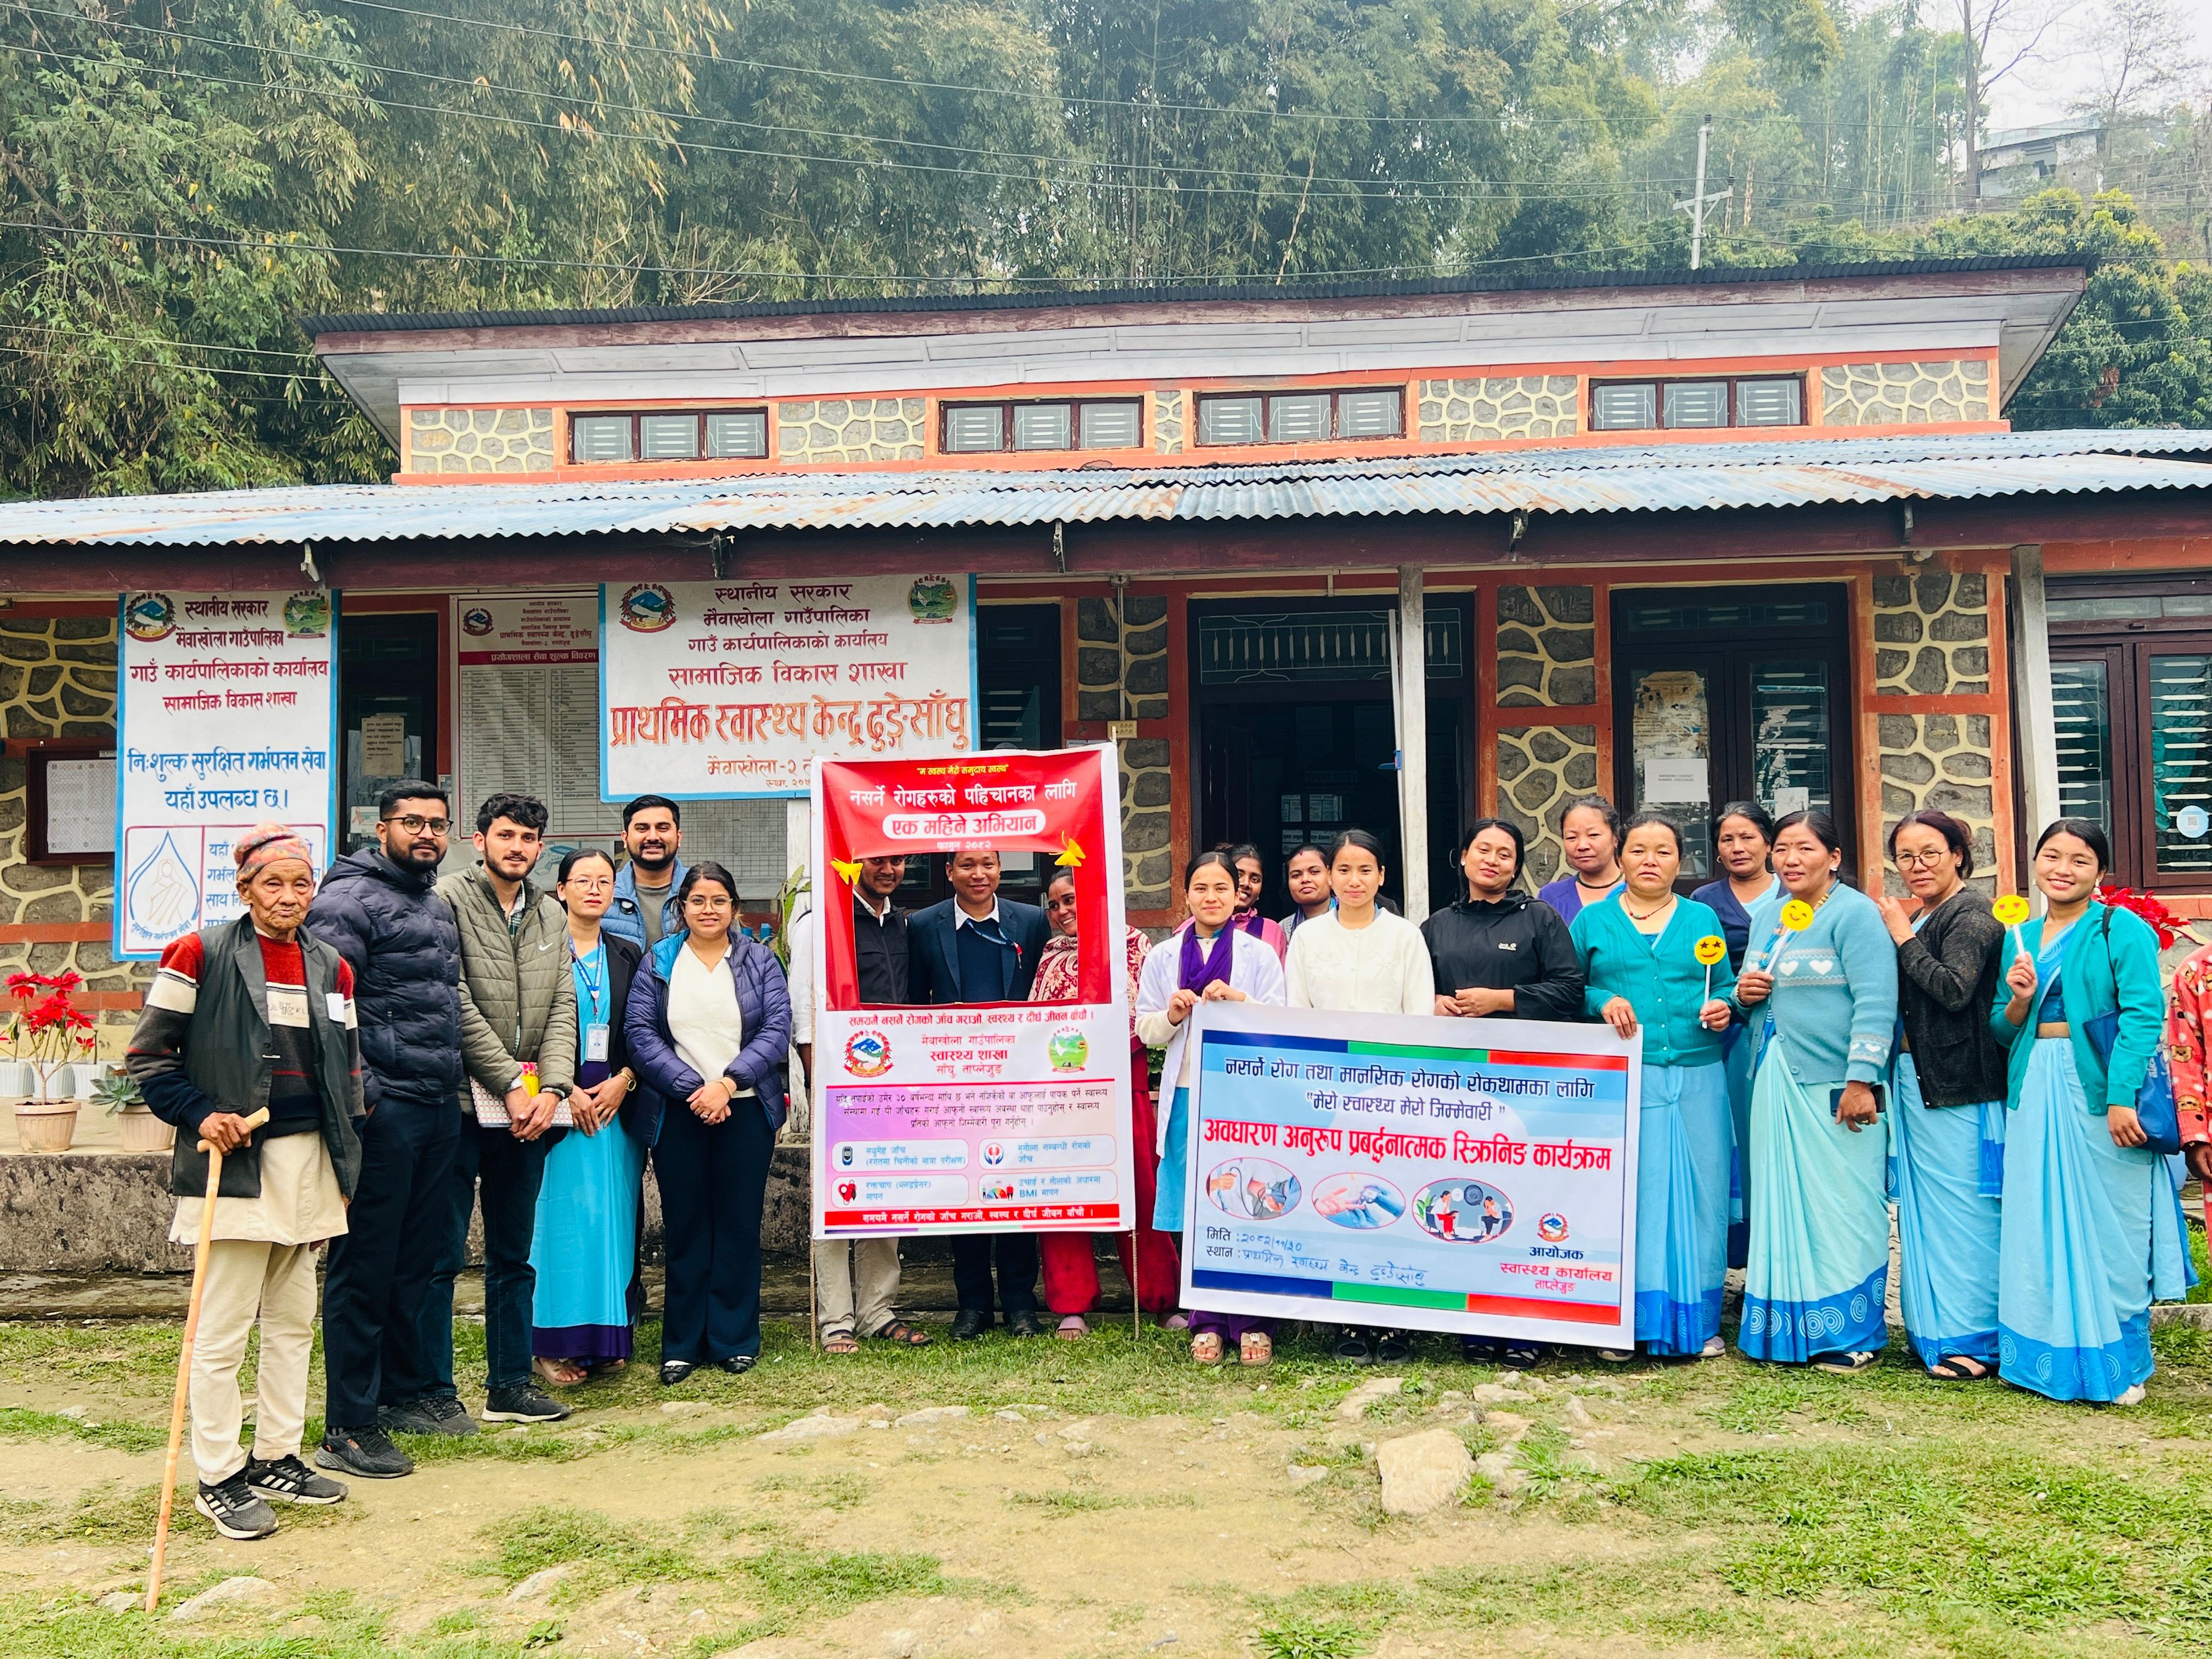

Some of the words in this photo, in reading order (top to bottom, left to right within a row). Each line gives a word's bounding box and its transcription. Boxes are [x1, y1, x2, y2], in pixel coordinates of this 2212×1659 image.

[715, 582, 778, 602] स्थानीय
[788, 584, 853, 602] सरकार
[184, 596, 229, 620] स्थानीय
[231, 600, 269, 621] सरकार
[703, 607, 773, 627] मैवाखोला
[784, 605, 871, 625] गाउँपालिका
[176, 626, 227, 651] मैवाखोला
[229, 627, 284, 650] गाउँपालिका
[689, 634, 718, 653] गाउँ
[723, 631, 828, 653] कार्यपालिकाको
[834, 631, 888, 650] कार्यालय
[491, 653, 531, 662] प्रयोगशाला
[549, 652, 568, 662] शुल्क
[571, 650, 596, 659] विवरण
[130, 658, 159, 682] गाउँ
[165, 658, 269, 681] कार्यपालिकाको
[273, 657, 329, 680] कार्यालय
[668, 661, 763, 687] सामाजिक
[773, 659, 838, 684] विकास
[849, 661, 908, 687] शाखा
[162, 690, 221, 715] सामाजिक
[225, 690, 263, 712] विकास
[266, 692, 297, 710] शाखा
[610, 696, 711, 748] प्राथमिक
[715, 702, 807, 744] स्वास्थ्य
[812, 694, 866, 747] केन्द्र
[192, 746, 245, 780] सुरक्षित
[248, 747, 298, 774] गर्भपतन
[301, 747, 325, 774] सेवा
[961, 765, 986, 776] समुदाय
[164, 783, 194, 812] यहाँ
[198, 790, 259, 811] उपलब्ध
[850, 785, 885, 807] नसर्ने
[964, 783, 1035, 806] पहिचानका
[1044, 780, 1077, 801] लागि
[891, 821, 918, 835] एक
[925, 815, 969, 836] महिने
[972, 812, 1038, 834] अभियान
[209, 839, 228, 856] यहाँ
[906, 1013, 933, 1025] रोगको
[1018, 1015, 1023, 1023] र
[1045, 1011, 1067, 1022] जीवन
[969, 1032, 1016, 1045] गाउँपालिका
[929, 1049, 973, 1060] स्वास्थ्य
[978, 1049, 1008, 1059] शाखा
[1225, 1057, 1265, 1076] नसर्ने
[1271, 1058, 1300, 1078] रोग
[1306, 1063, 1334, 1081] तथा
[1340, 1065, 1405, 1087] मानसिक
[1412, 1068, 1462, 1090] रोगको
[1467, 1072, 1550, 1096] रोकथामका
[1556, 1077, 1595, 1098] लागि
[878, 1092, 892, 1102] उमेर
[938, 1091, 952, 1101] माथि
[1343, 1096, 1395, 1113] स्वास्थ्य
[1400, 1096, 1425, 1116] मेरो
[1071, 1139, 1091, 1149] रोगको
[1204, 1118, 1278, 1147] अवधारण
[1283, 1125, 1343, 1156] अनुरूप
[1453, 1130, 1528, 1165] स्क्रिनिङ
[1533, 1138, 1612, 1171] कार्यक्रम
[1019, 1189, 1037, 1198] BMI
[1013, 1210, 1019, 1219] र
[1206, 1227, 1231, 1242] मिति
[1206, 1245, 1233, 1259] स्थान
[1529, 1245, 1584, 1260] आयोजक
[1500, 1263, 1549, 1276] स्वास्थ्य
[1555, 1267, 1612, 1282] कार्यालय
[1534, 1279, 1576, 1294] ताप्लेजुङ
